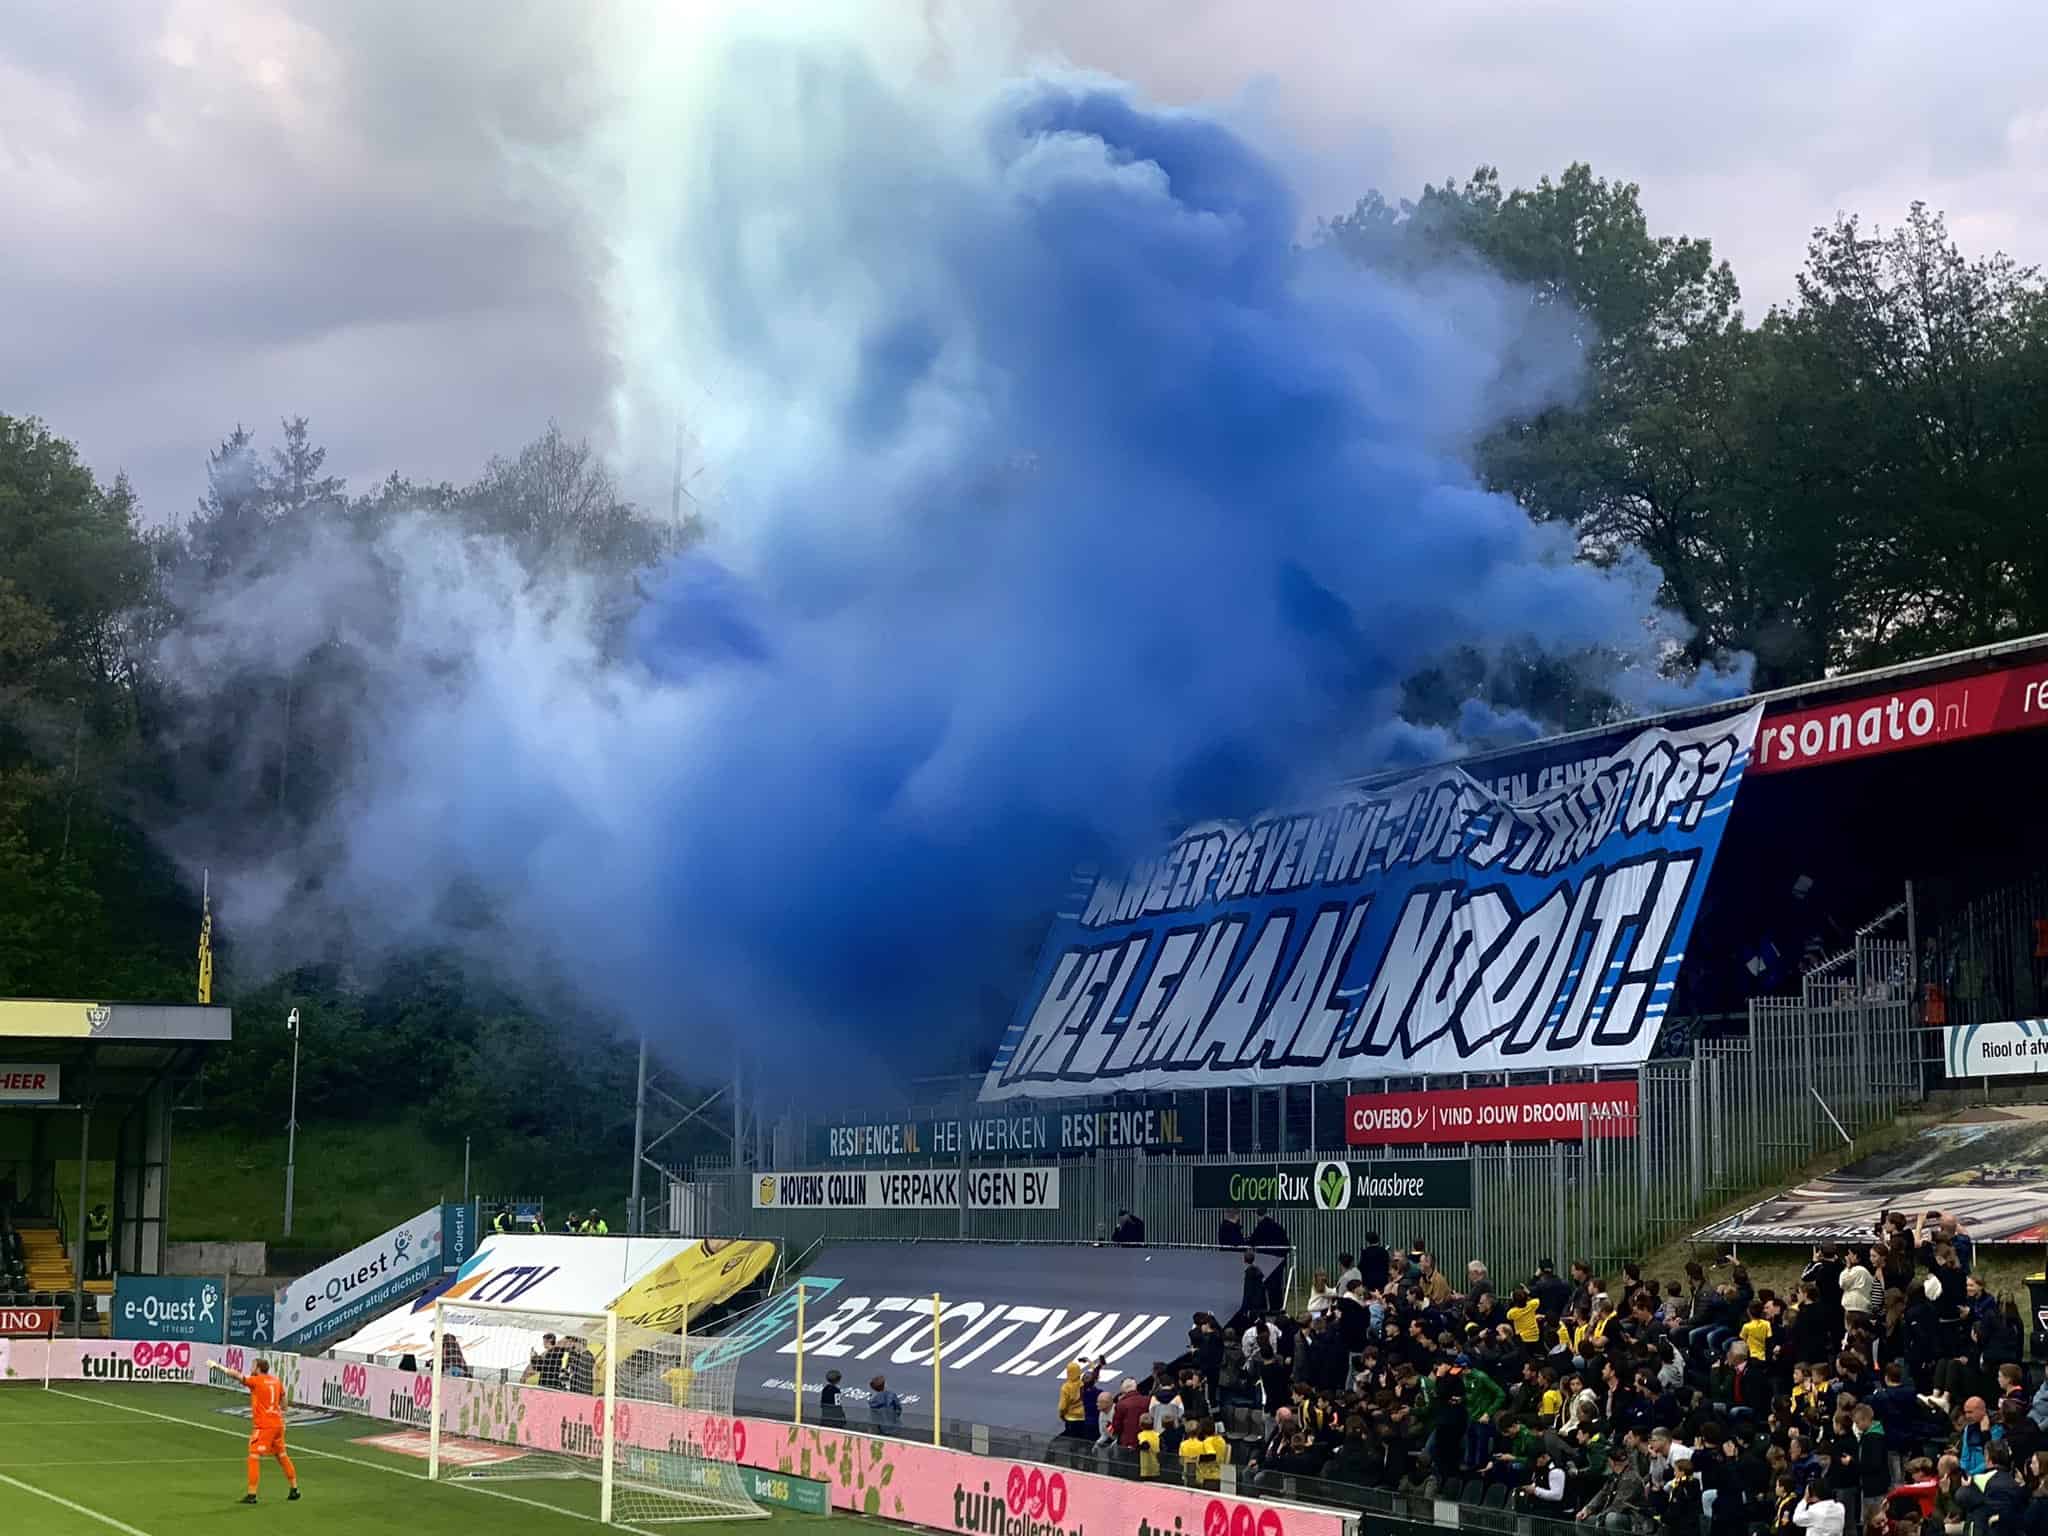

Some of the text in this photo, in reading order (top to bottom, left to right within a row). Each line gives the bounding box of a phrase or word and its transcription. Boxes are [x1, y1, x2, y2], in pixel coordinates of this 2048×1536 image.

[1745, 690, 1968, 765] rsonato.nl
[1004, 848, 1702, 1083] HELEMAAL NOOIT!
[1982, 1040, 2012, 1058] Riool
[2015, 1039, 2027, 1056] of
[1353, 1107, 1412, 1130] COVEBO
[1440, 1106, 1473, 1125] VIND
[1476, 1104, 1519, 1124] JOUW
[780, 1171, 1050, 1206] HOVENS COLLIN VERPAKKNGEN BV
[1357, 1172, 1424, 1198] Maasbree
[455, 1207, 465, 1264] e-Quest.nl
[304, 1252, 388, 1312] e-Quest
[366, 1287, 389, 1309] altijd
[391, 1265, 430, 1293] dichtbij!
[2, 1312, 41, 1329] INO
[125, 1296, 195, 1326] e-Quest
[82, 1352, 133, 1380] tuin
[321, 1376, 342, 1407] tuin
[390, 1386, 413, 1421] tuin
[755, 1475, 789, 1501] bet365
[954, 1481, 1006, 1535] tuin
